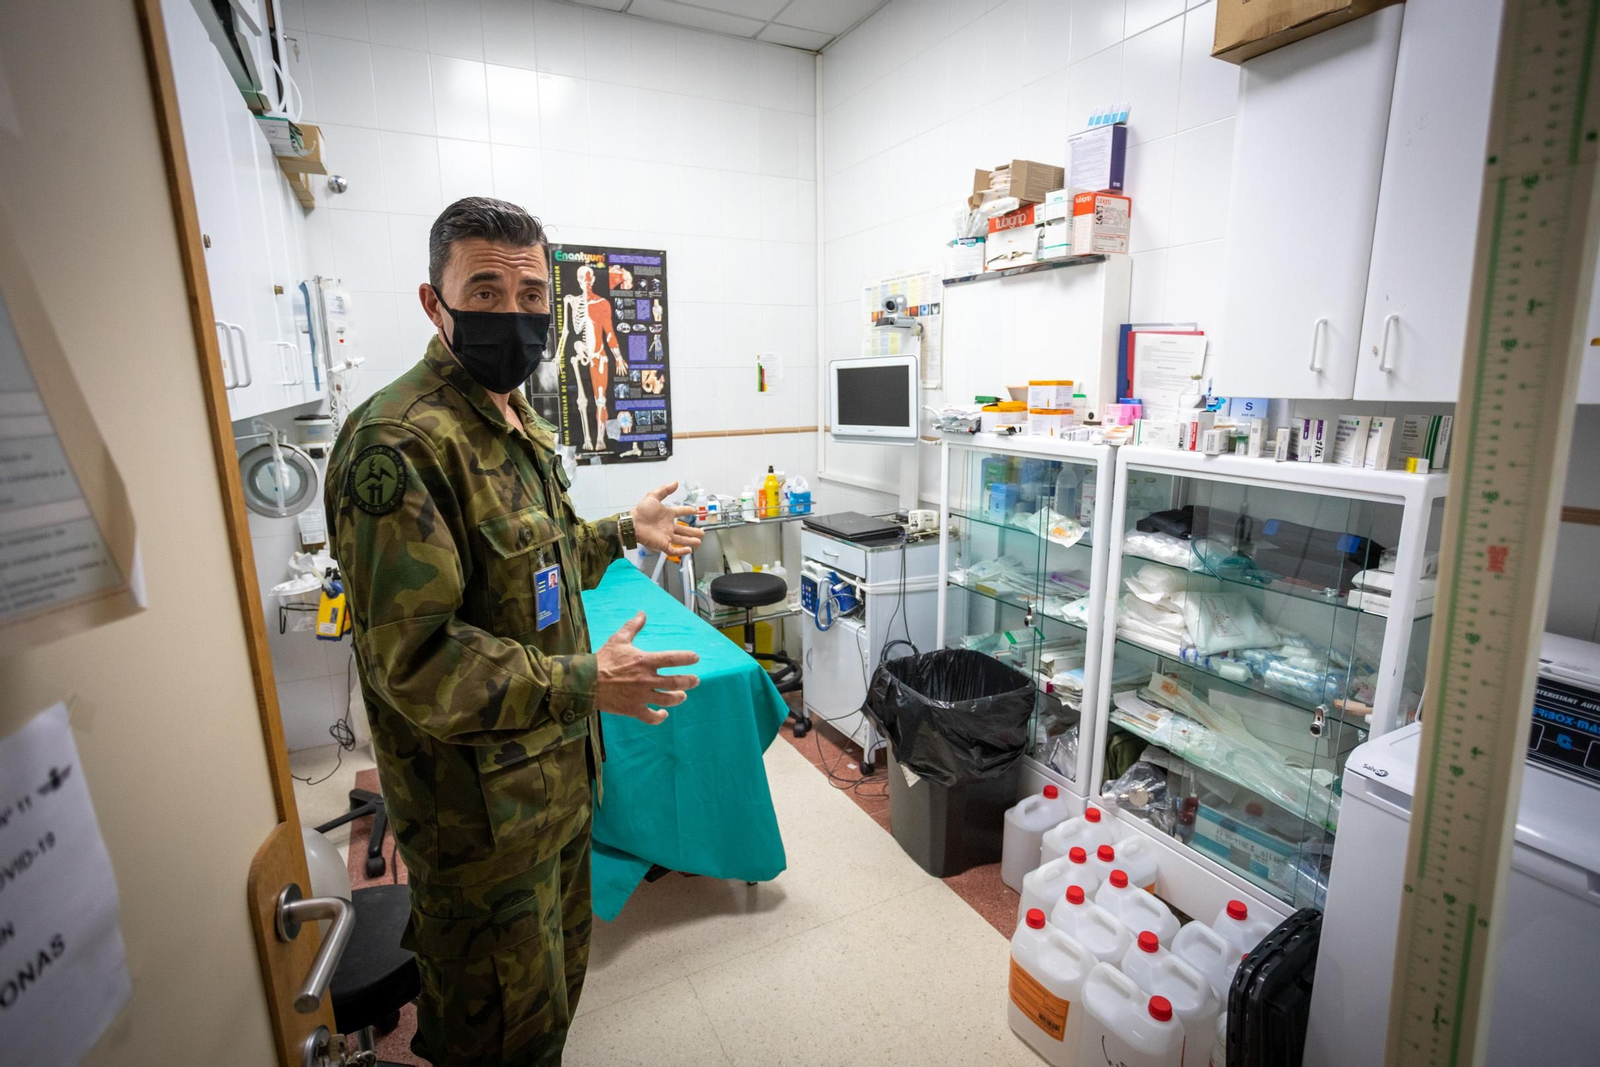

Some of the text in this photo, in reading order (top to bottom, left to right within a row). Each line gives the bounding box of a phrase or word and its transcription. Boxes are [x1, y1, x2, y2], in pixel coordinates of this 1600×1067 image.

[995, 211, 1027, 230] tubigrip
[554, 249, 606, 264] Enantyum
[1245, 402, 1253, 411] S
[367, 483, 383, 504] 11
